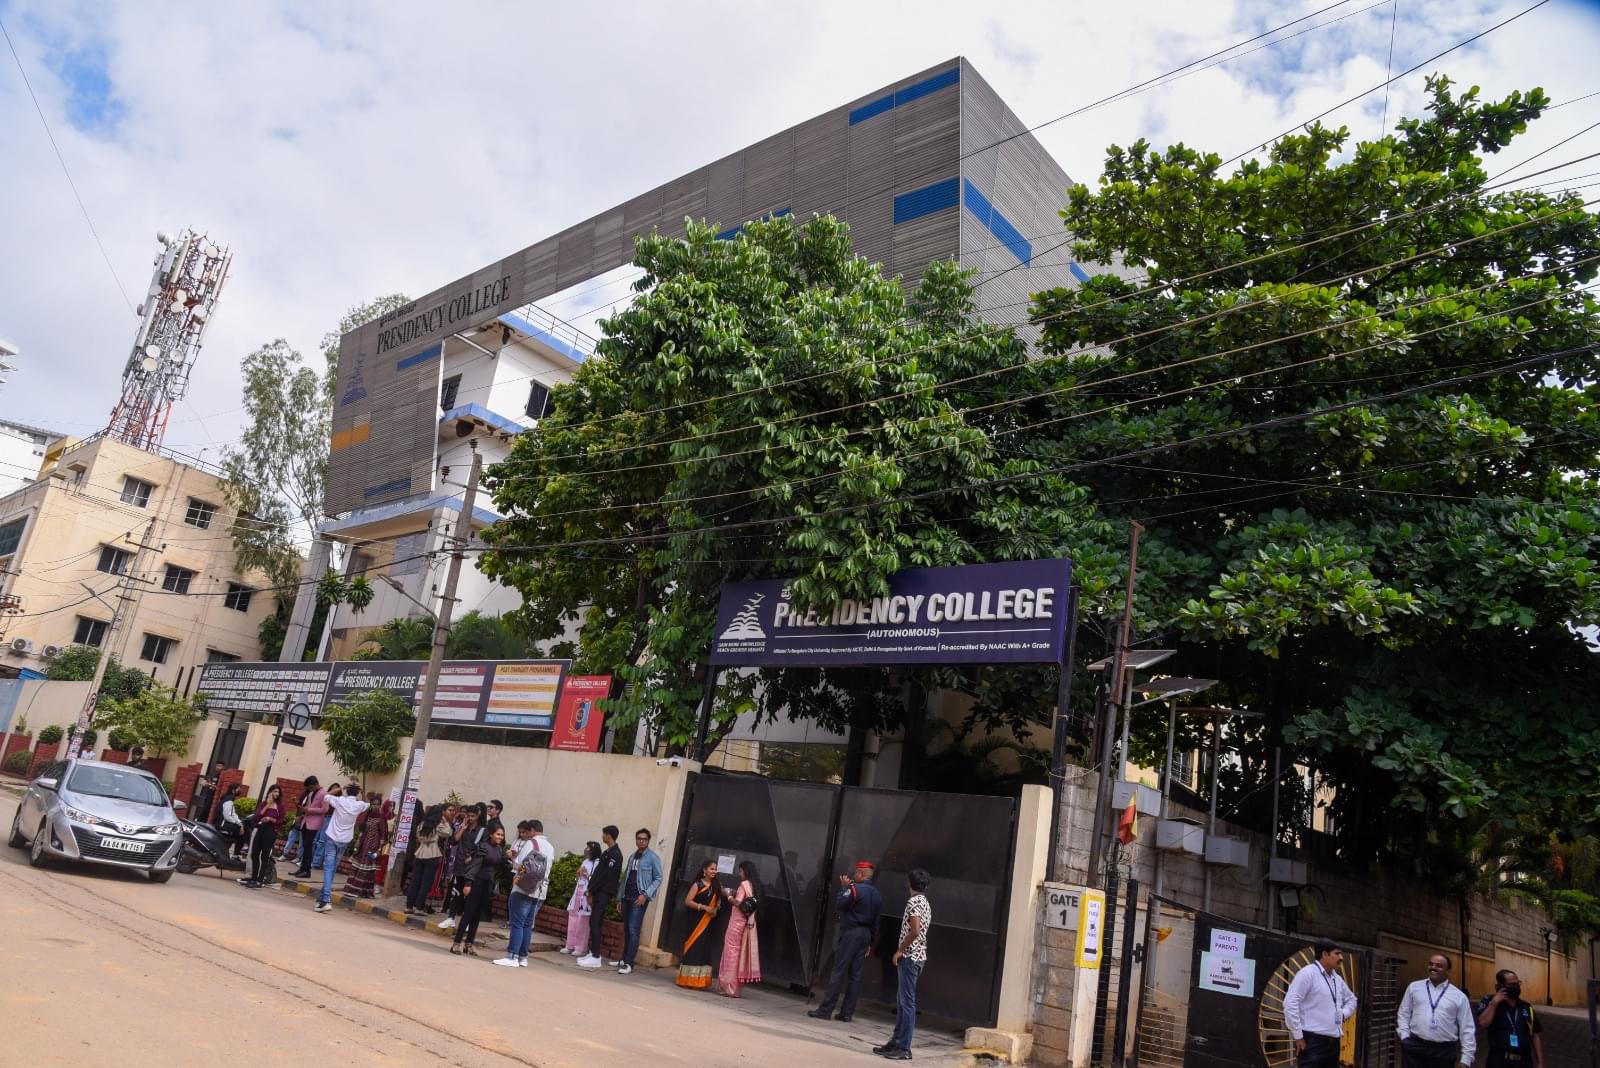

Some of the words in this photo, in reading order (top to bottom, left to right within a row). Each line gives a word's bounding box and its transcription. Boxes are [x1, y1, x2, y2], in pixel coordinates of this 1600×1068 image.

[376, 303, 446, 354] PRESIDENCY
[448, 275, 511, 324] COLLEGE
[927, 587, 1055, 623] COLLEGE
[867, 627, 940, 639] (AUTONOMOUS)
[980, 643, 988, 651] By
[208, 669, 234, 679] PRESIDENCY
[234, 670, 254, 679] COLLEGE
[343, 676, 384, 688] PRESIDENCY
[385, 676, 416, 689] COLLEGE
[405, 794, 417, 804] PG
[401, 815, 412, 823] PG
[1050, 893, 1078, 908] GATE
[1059, 909, 1067, 926] 1
[1215, 943, 1239, 952] PARENTS
